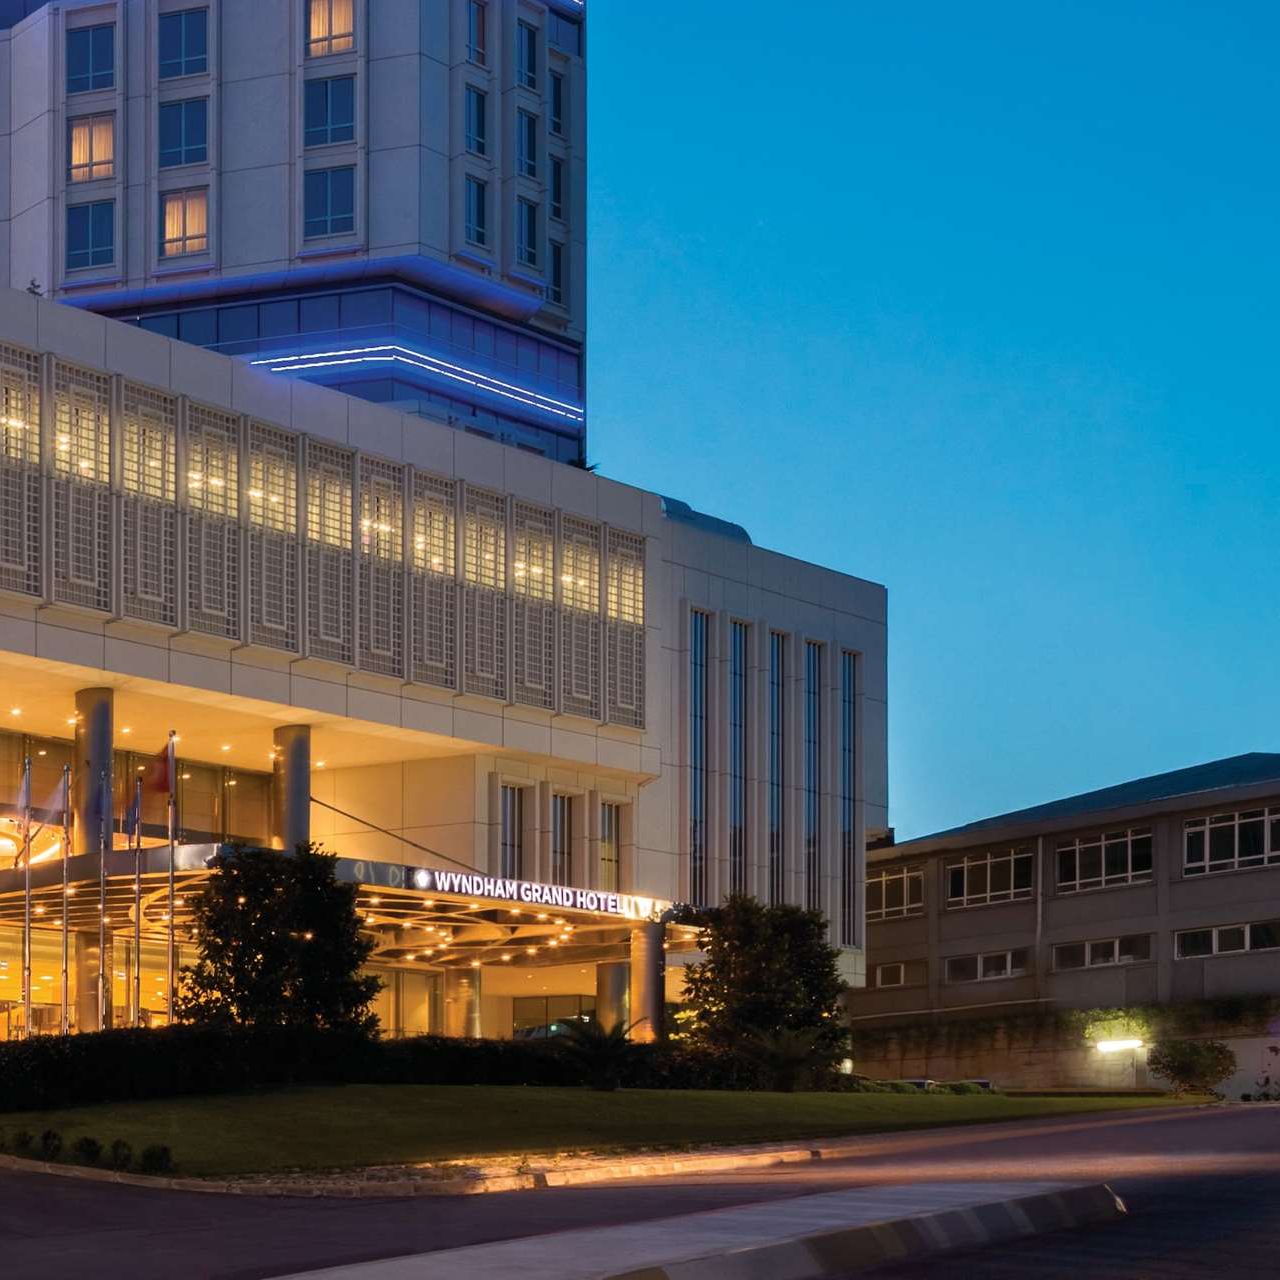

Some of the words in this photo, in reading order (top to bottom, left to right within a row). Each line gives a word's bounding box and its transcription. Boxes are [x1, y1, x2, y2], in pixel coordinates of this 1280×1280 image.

[434, 871, 518, 900] WYNDHAM
[520, 883, 573, 907] GRAND
[576, 889, 625, 914] HOTEL
